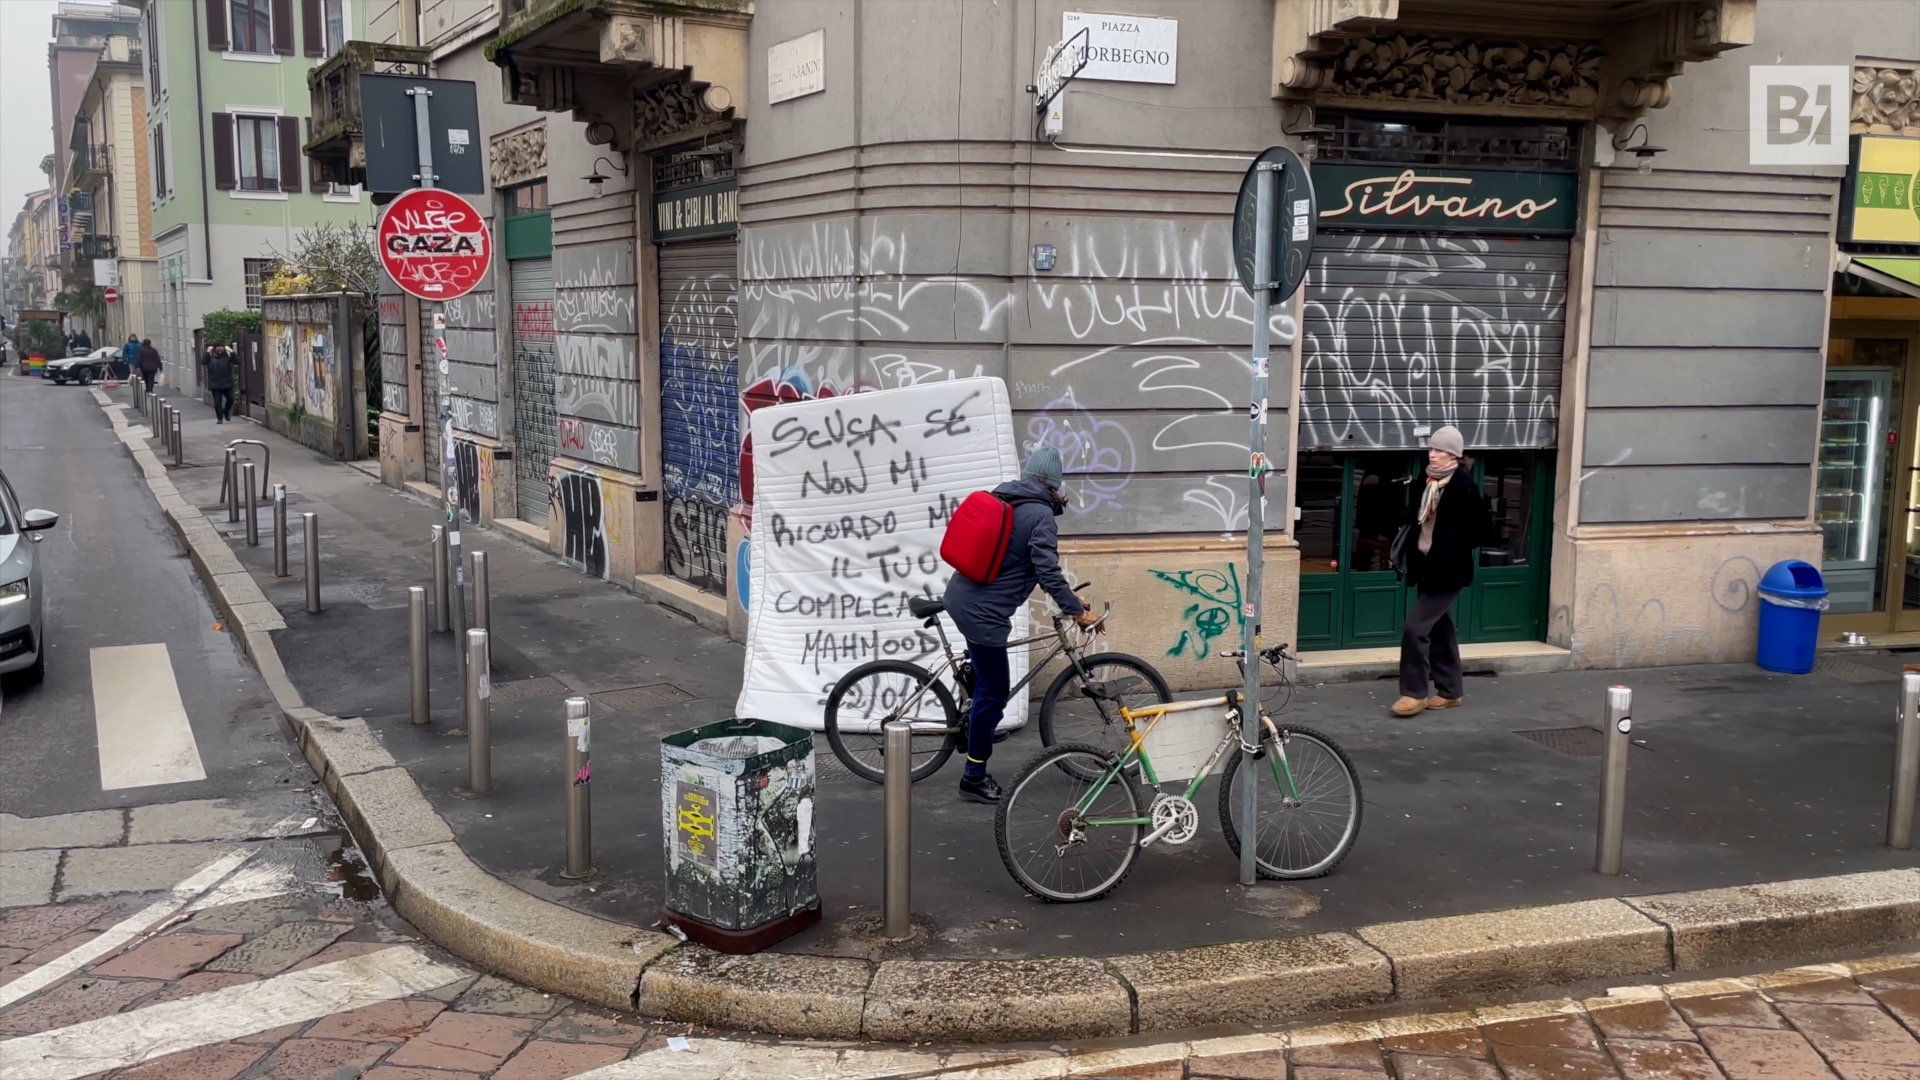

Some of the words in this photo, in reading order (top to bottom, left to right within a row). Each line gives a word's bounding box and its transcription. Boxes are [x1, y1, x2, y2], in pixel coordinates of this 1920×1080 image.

[1101, 22, 1141, 33] PIAZZA
[657, 201, 674, 231] VINI
[675, 200, 683, 229] &
[685, 196, 702, 228] CIBI
[704, 194, 715, 226] AL
[1319, 169, 1557, 219] Silvano
[387, 236, 477, 253] GAZA
[770, 408, 902, 457] SCUSA
[801, 450, 868, 499] NON
[889, 450, 928, 493] MI
[771, 510, 897, 548] RICORDO
[831, 556, 863, 579] IL
[866, 545, 939, 584] TUO
[801, 628, 941, 676] MAHMOOD
